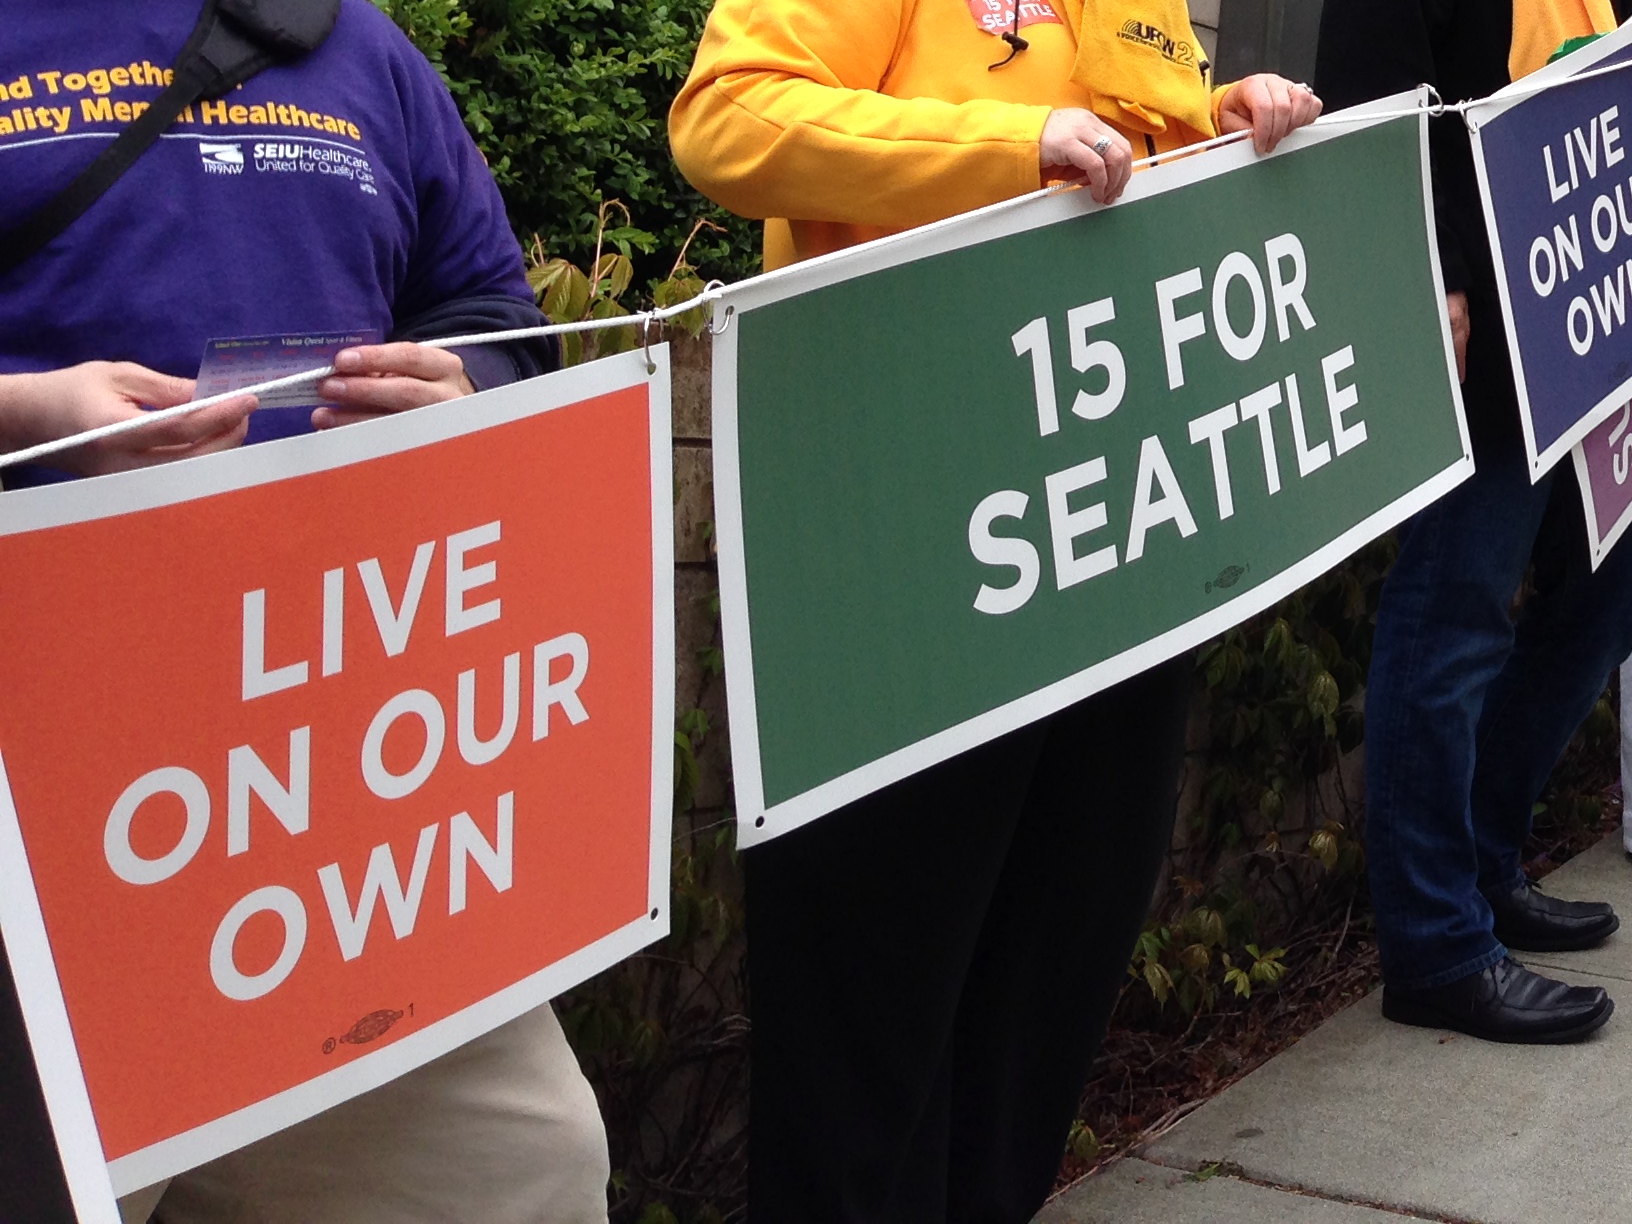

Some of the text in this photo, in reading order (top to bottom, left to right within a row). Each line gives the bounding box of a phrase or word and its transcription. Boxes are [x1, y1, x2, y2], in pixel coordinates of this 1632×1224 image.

[982, 3, 1055, 29] SEATTLE
[1137, 21, 1175, 56] UFCW
[37, 60, 175, 95] Togethe
[80, 97, 195, 123] Menl
[201, 100, 362, 141] Healthcare
[255, 159, 375, 184] United for Quality Care
[1542, 104, 1625, 204] LIVE
[1529, 215, 1584, 298] ON
[1011, 232, 1318, 436] 15 FOR
[967, 345, 1367, 615] SEATTLE
[242, 520, 501, 701] LIVE
[103, 632, 590, 885] ON OUR
[210, 791, 514, 1001] OWN
